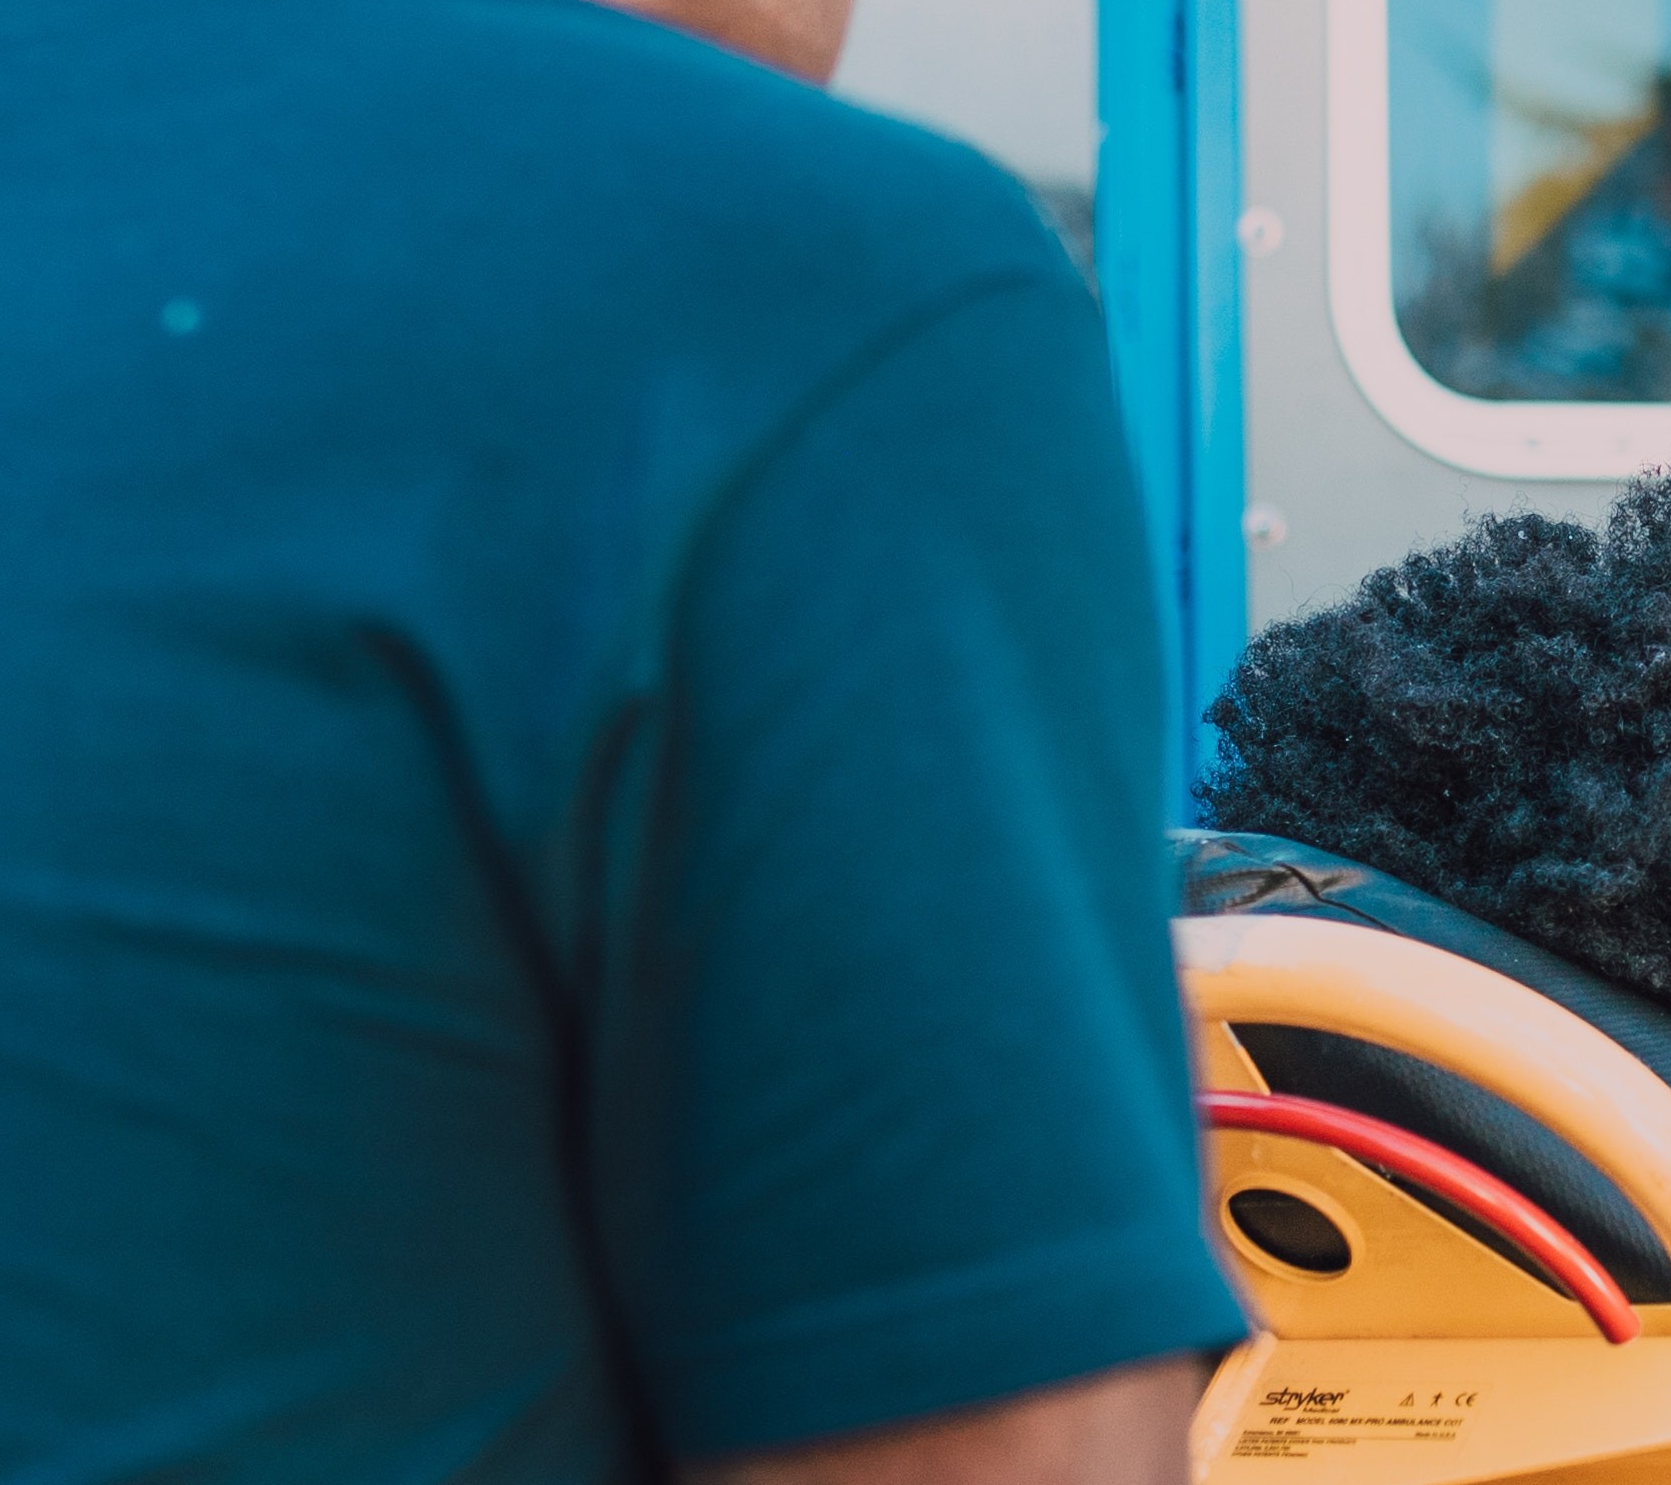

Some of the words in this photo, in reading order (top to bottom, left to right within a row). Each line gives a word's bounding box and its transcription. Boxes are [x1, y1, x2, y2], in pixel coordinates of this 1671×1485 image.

[1258, 1387, 1346, 1412] stryker
[1269, 1417, 1290, 1425] REF
[1296, 1417, 1326, 1425] MODEL
[1385, 1418, 1443, 1427] AMBULANCE
